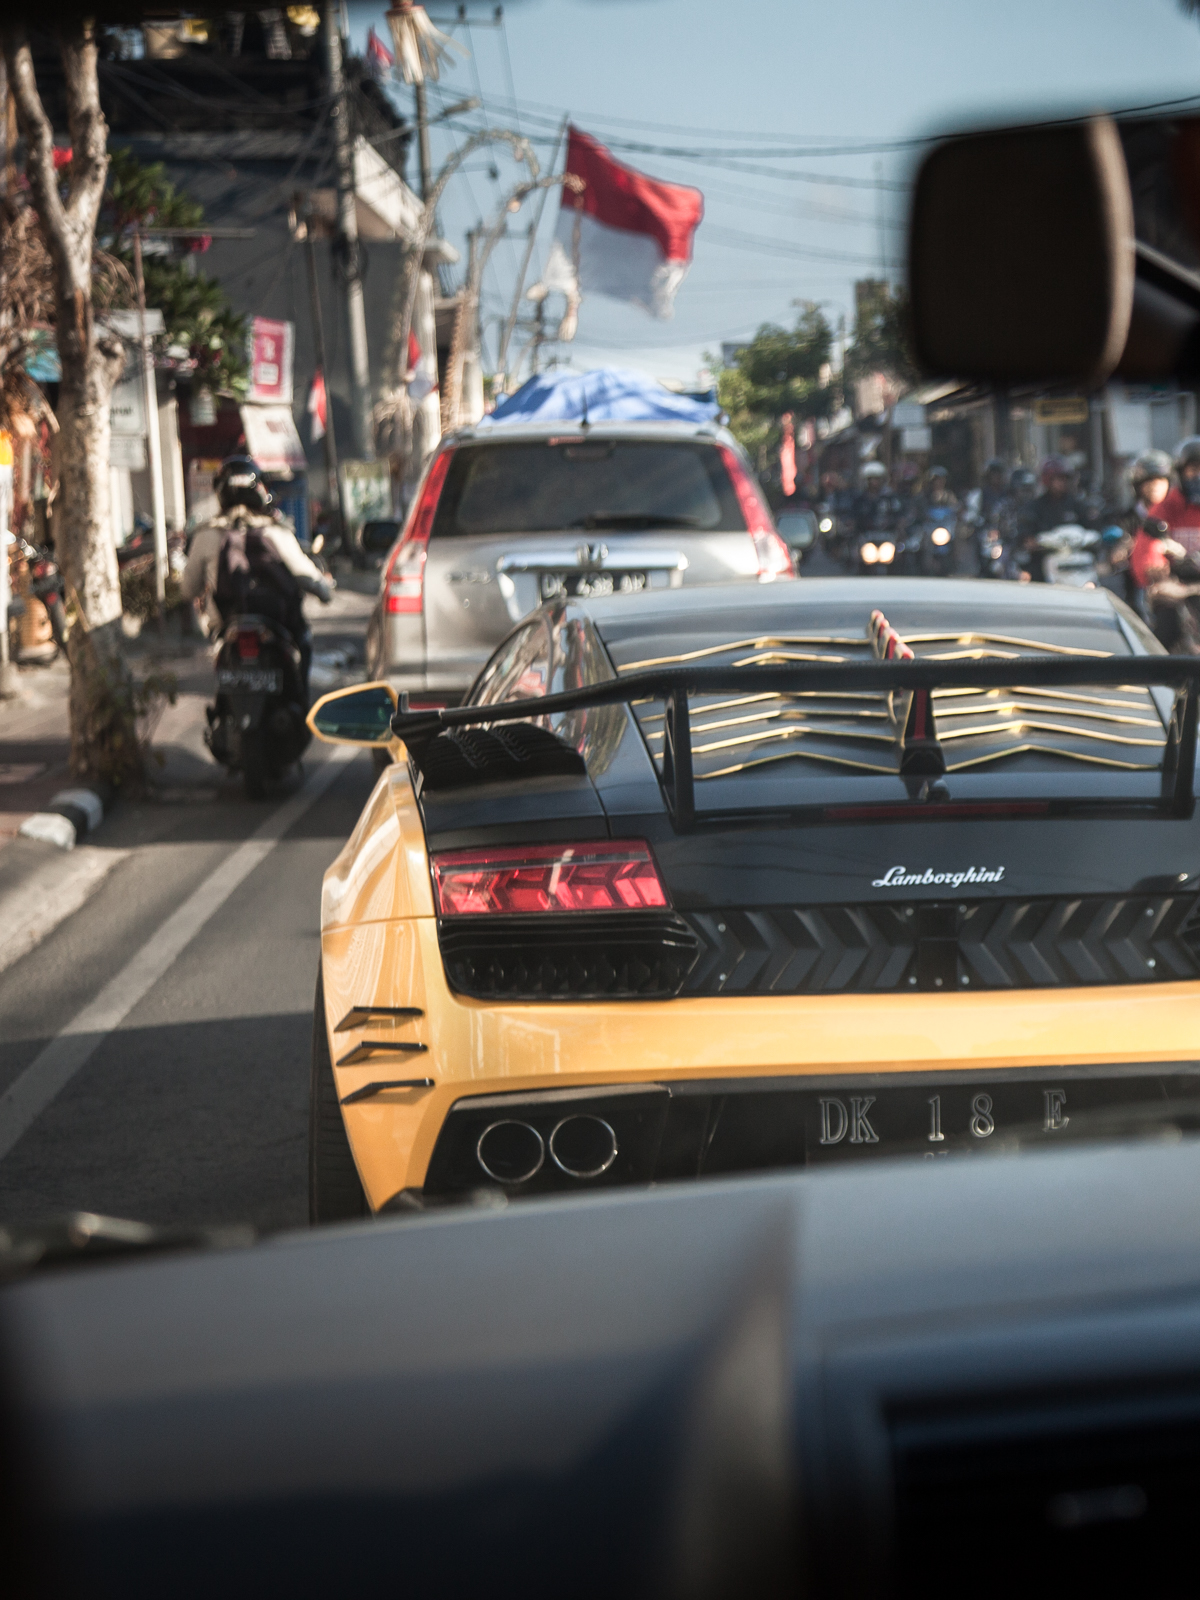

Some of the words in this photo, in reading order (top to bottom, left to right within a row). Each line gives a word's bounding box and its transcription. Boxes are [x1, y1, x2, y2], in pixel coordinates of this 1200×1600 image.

[871, 865, 1005, 888] Lamborghini
[819, 1096, 880, 1145] DK
[1043, 1089, 1070, 1132] E
